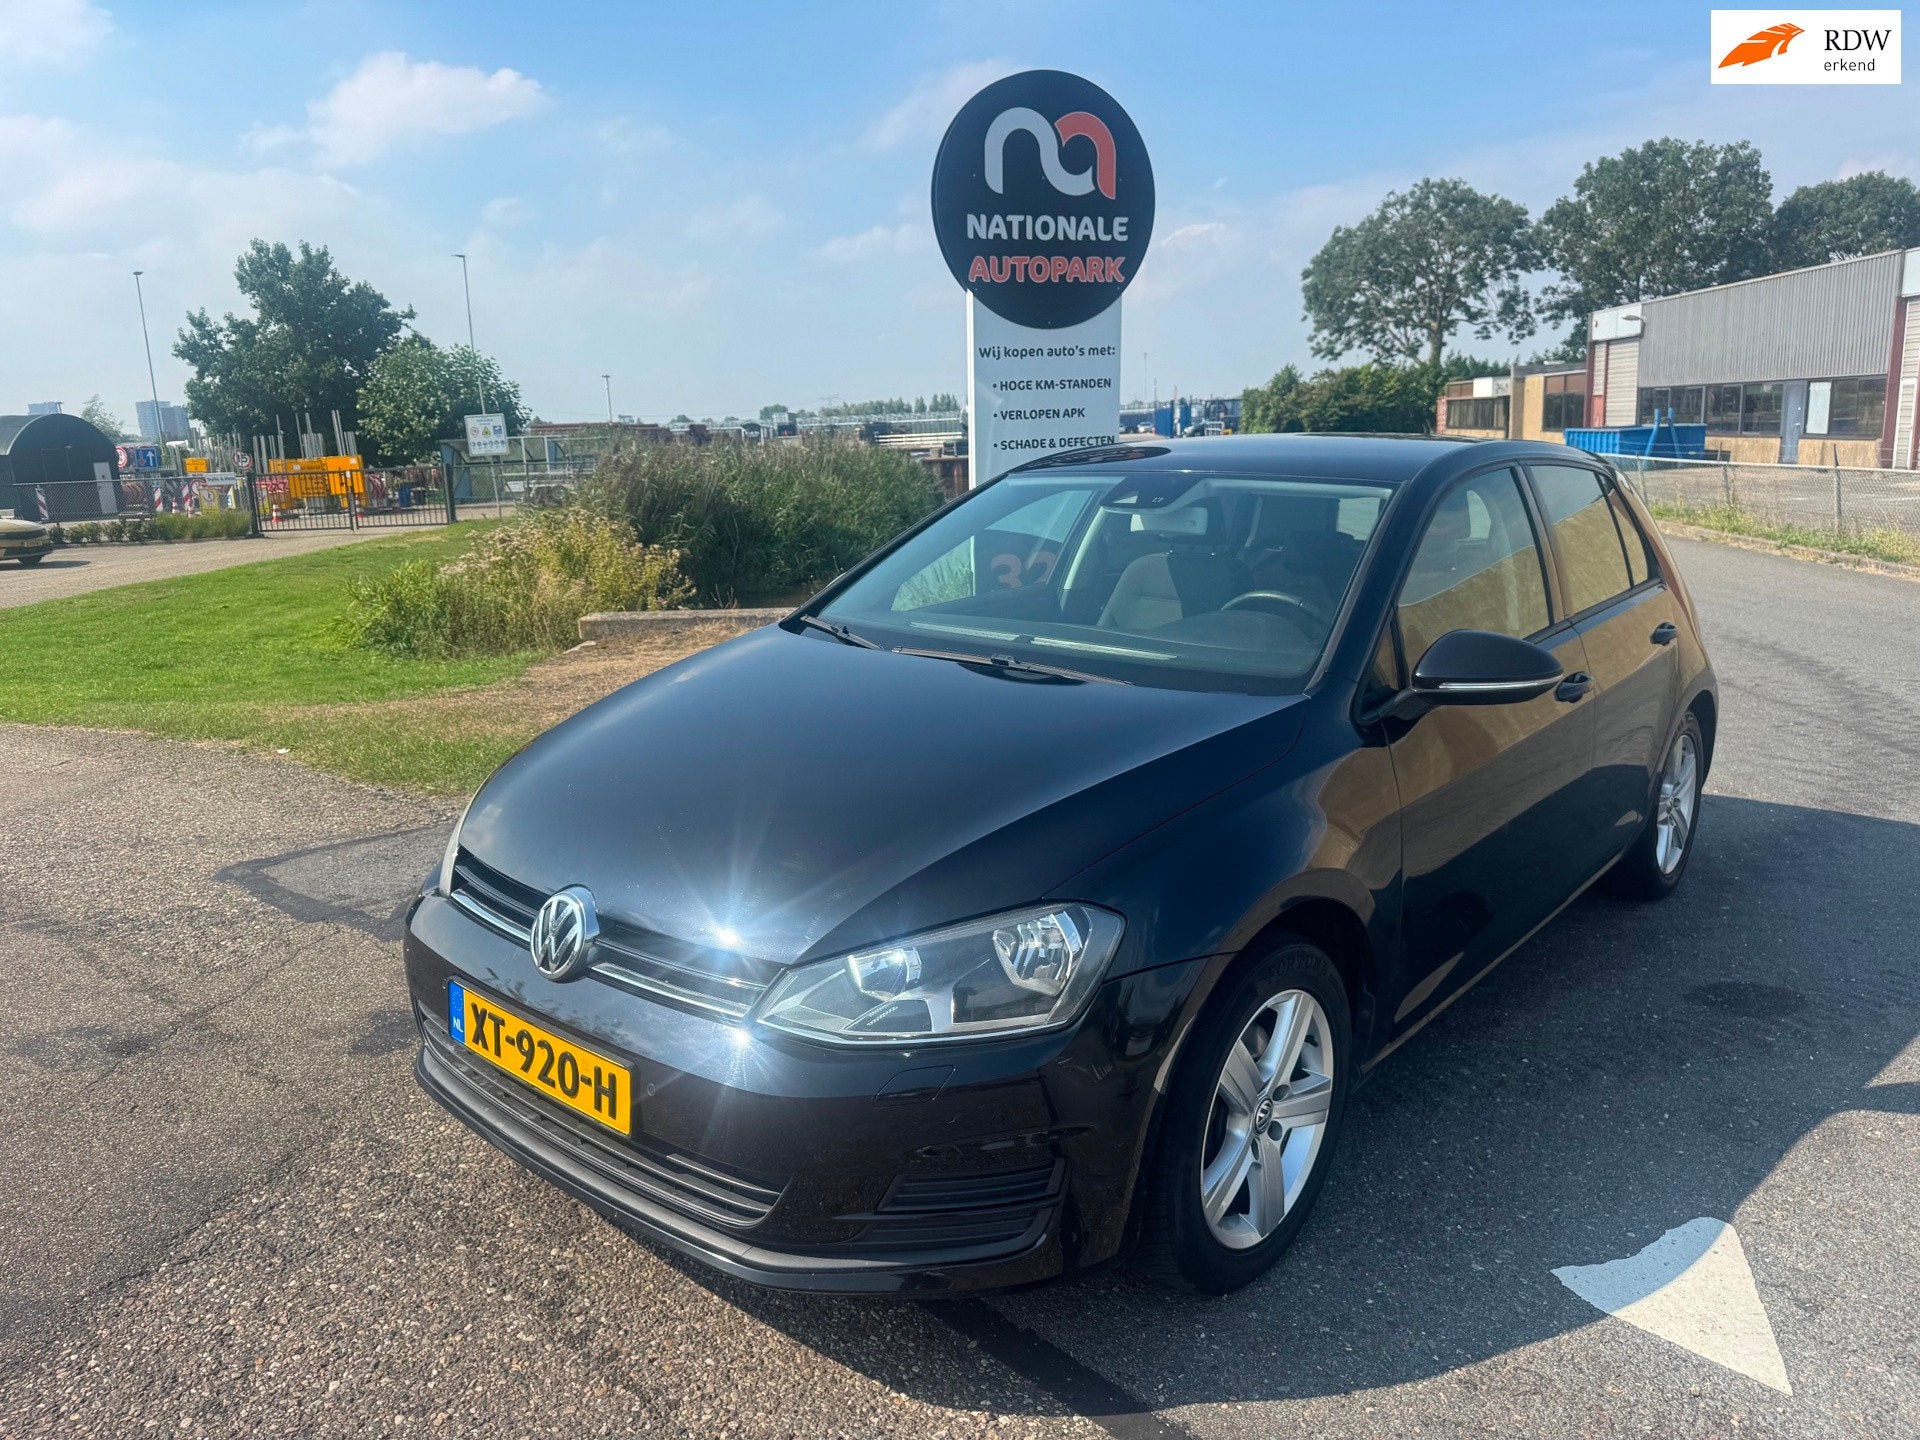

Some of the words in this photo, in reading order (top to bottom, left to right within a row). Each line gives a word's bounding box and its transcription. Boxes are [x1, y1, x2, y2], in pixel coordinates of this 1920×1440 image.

[967, 214, 1129, 242] NATIONALE
[968, 255, 1126, 283] AUTOPARK
[979, 346, 1001, 360] Wij
[1004, 346, 1044, 359] kopen
[1047, 345, 1085, 357] auto's
[1088, 345, 1115, 356] met:
[1000, 380, 1033, 391] HOGE
[1035, 378, 1112, 390] KM-STANDEN
[1000, 408, 1060, 420] VERLOPEN
[1062, 407, 1085, 418] APK
[1000, 438, 1047, 450] SCHADE
[1048, 439, 1057, 448] &
[1059, 435, 1115, 448] DEFECTEN
[453, 1016, 464, 1033] NL
[471, 1002, 617, 1120] XT-920-H
